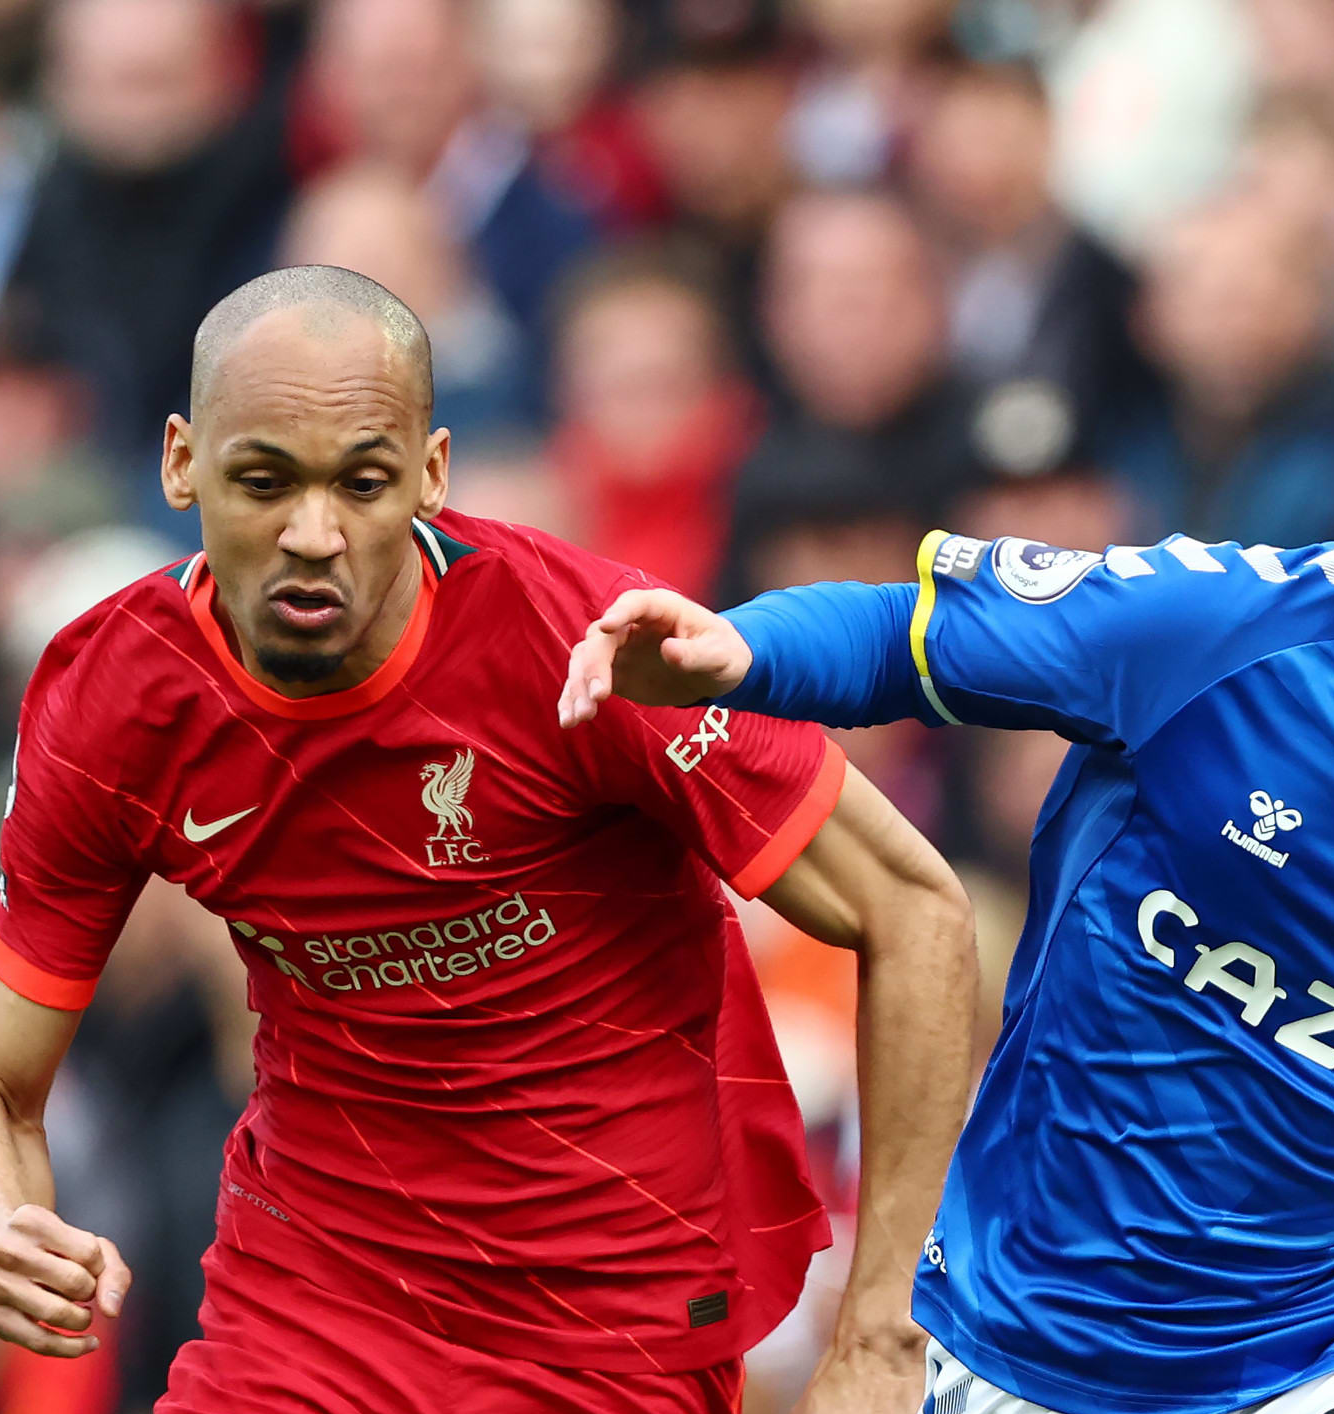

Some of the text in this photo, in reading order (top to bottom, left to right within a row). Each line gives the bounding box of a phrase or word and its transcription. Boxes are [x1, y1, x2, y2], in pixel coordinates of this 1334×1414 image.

[424, 842, 490, 867] L.F.C.
[1220, 819, 1290, 869] hummel
[304, 891, 530, 964] standard
[322, 908, 557, 991] chartered
